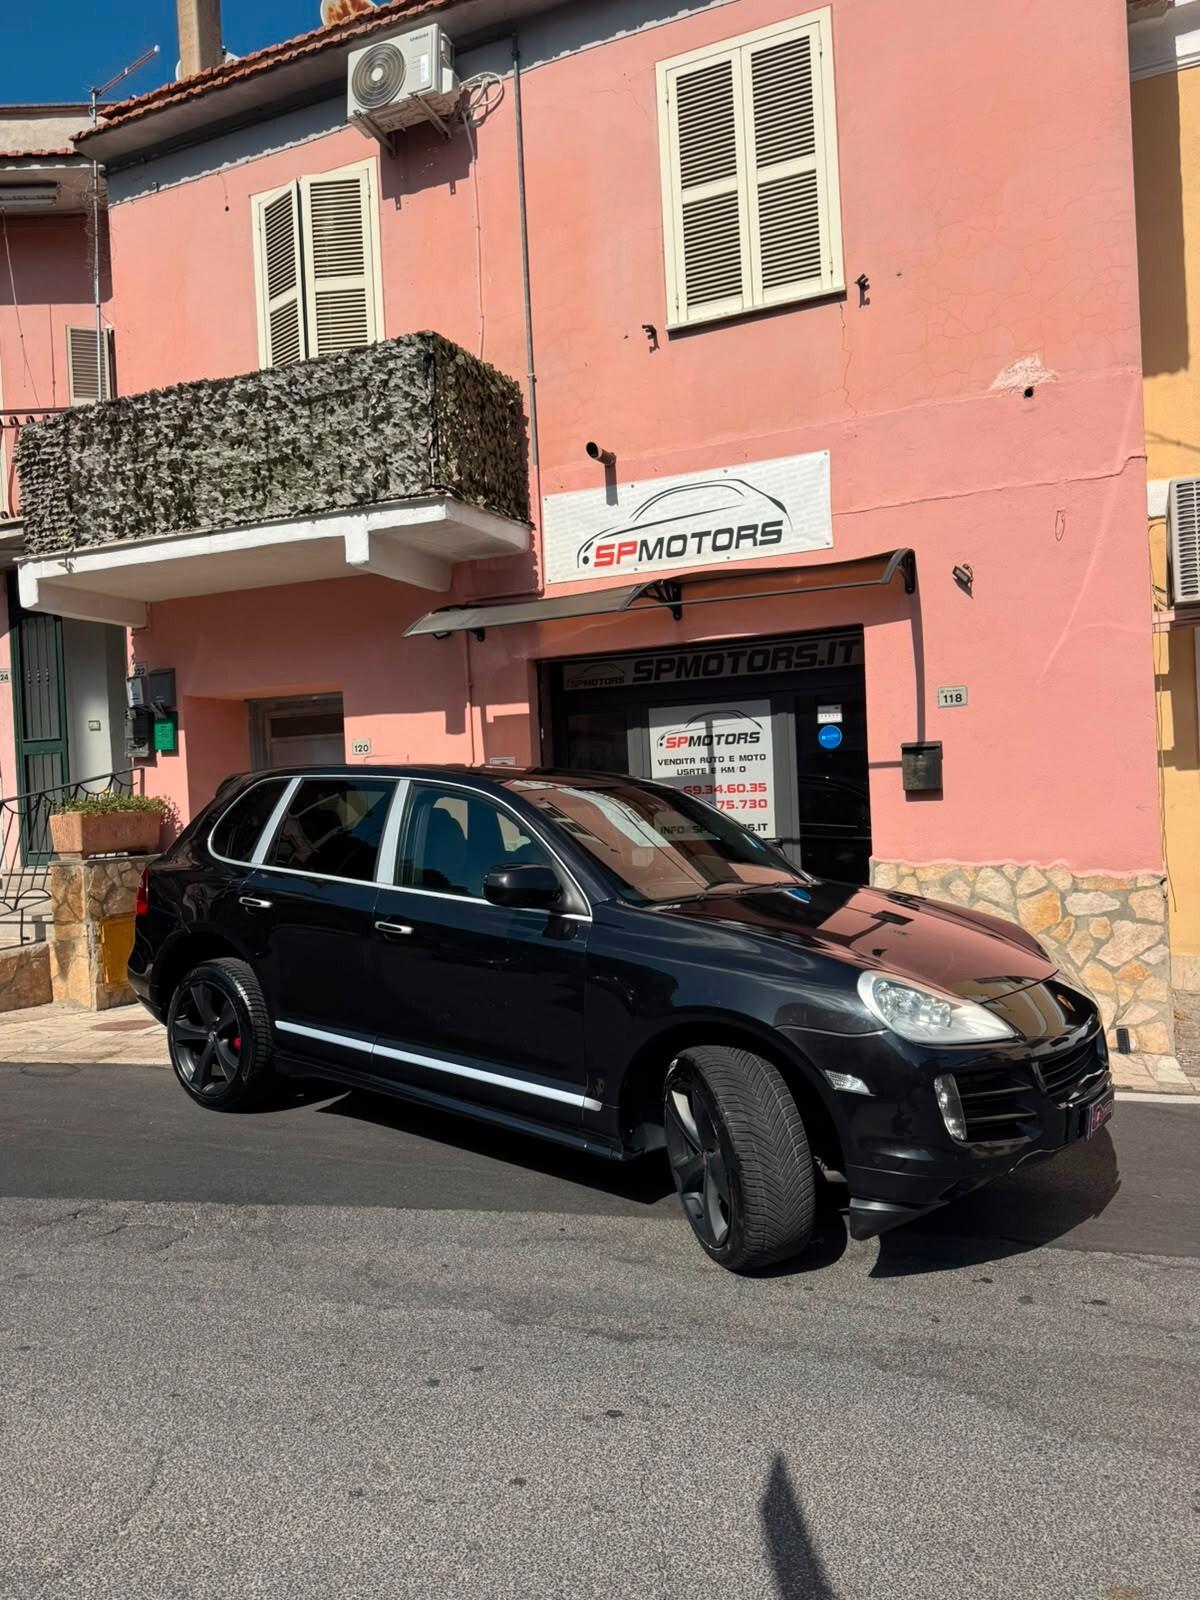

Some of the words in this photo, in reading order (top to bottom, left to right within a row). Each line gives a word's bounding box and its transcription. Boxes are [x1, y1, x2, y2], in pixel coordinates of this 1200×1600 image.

[593, 519, 783, 568] SPMOTORS
[632, 639, 861, 682] SPMOTORS.IT
[943, 693, 962, 704] 118
[665, 731, 761, 749] SPMOTORS
[354, 744, 369, 753] 120
[657, 757, 696, 767] VENDITA
[699, 755, 725, 764] AUTO
[728, 755, 735, 763] E
[738, 753, 767, 762] MOTO
[676, 767, 707, 776] USATE
[710, 767, 717, 775] E
[720, 765, 736, 774] KM
